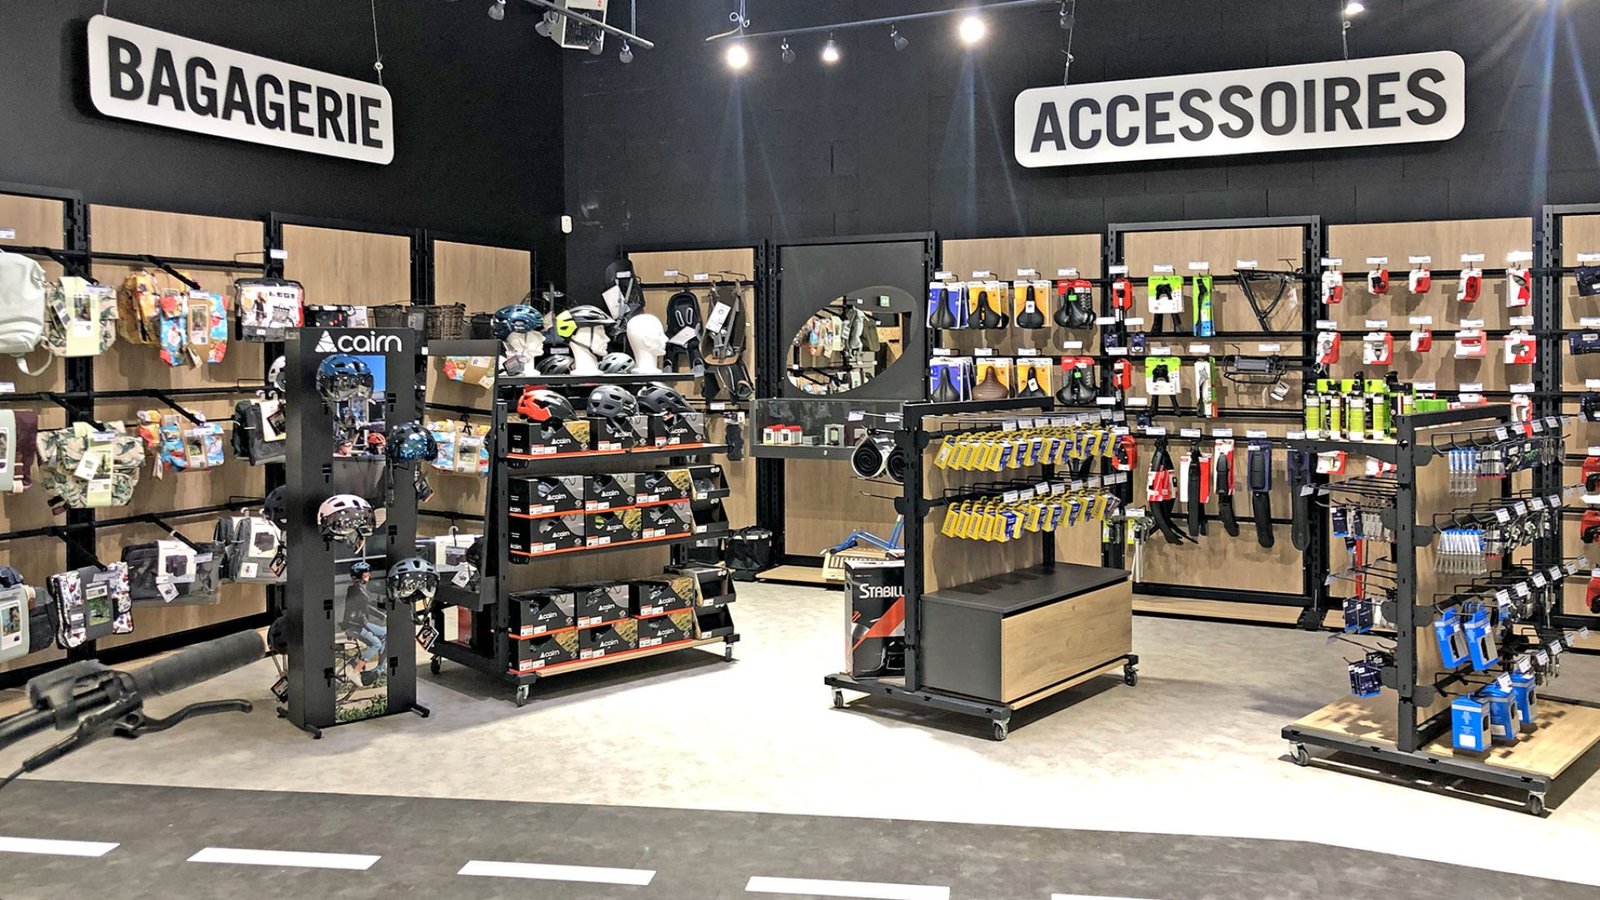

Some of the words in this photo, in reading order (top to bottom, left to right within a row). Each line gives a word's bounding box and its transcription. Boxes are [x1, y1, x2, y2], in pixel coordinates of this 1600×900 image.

[107, 35, 383, 149] BAGAGERIE
[1030, 68, 1447, 153] ACCESSOIRES
[338, 330, 402, 352] cairn
